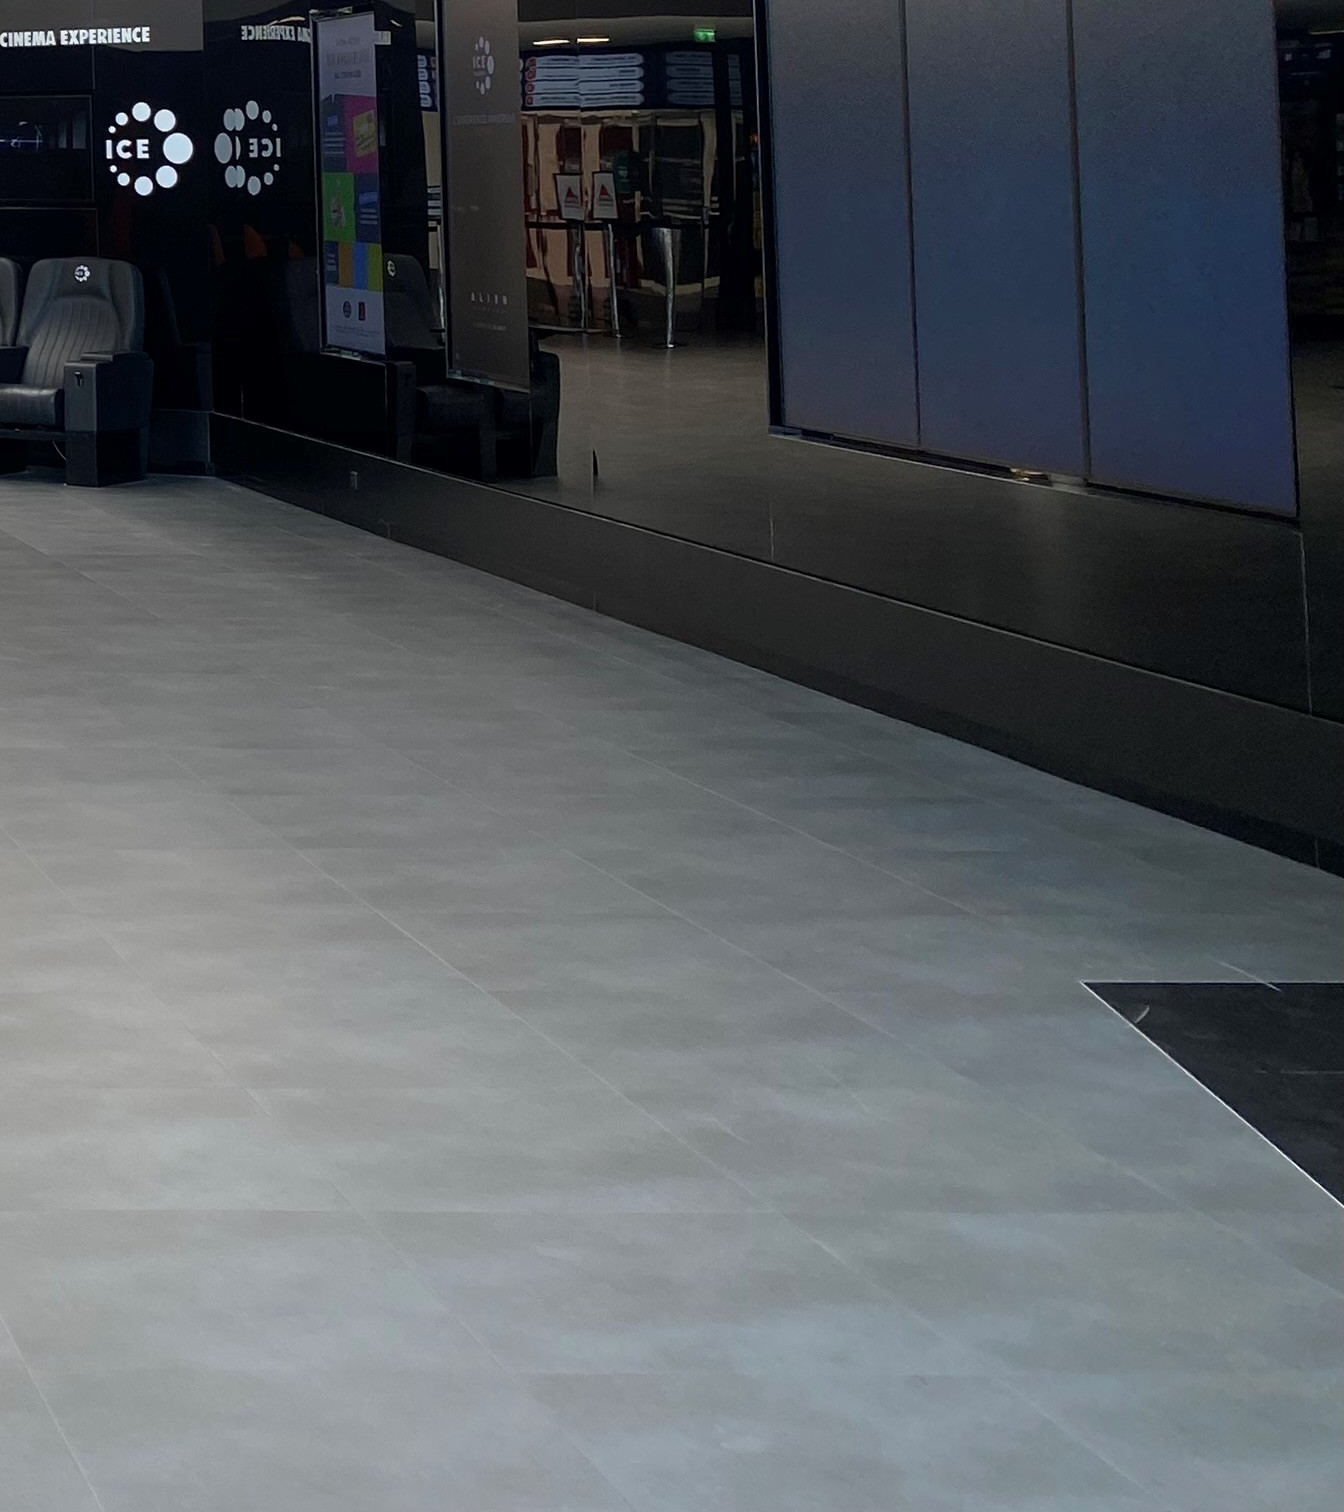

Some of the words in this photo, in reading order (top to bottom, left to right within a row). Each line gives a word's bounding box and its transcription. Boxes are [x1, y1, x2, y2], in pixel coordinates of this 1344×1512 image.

[0, 30, 56, 47] CINEMA
[60, 26, 151, 45] EXPERIENCE
[105, 139, 150, 159] ICE
